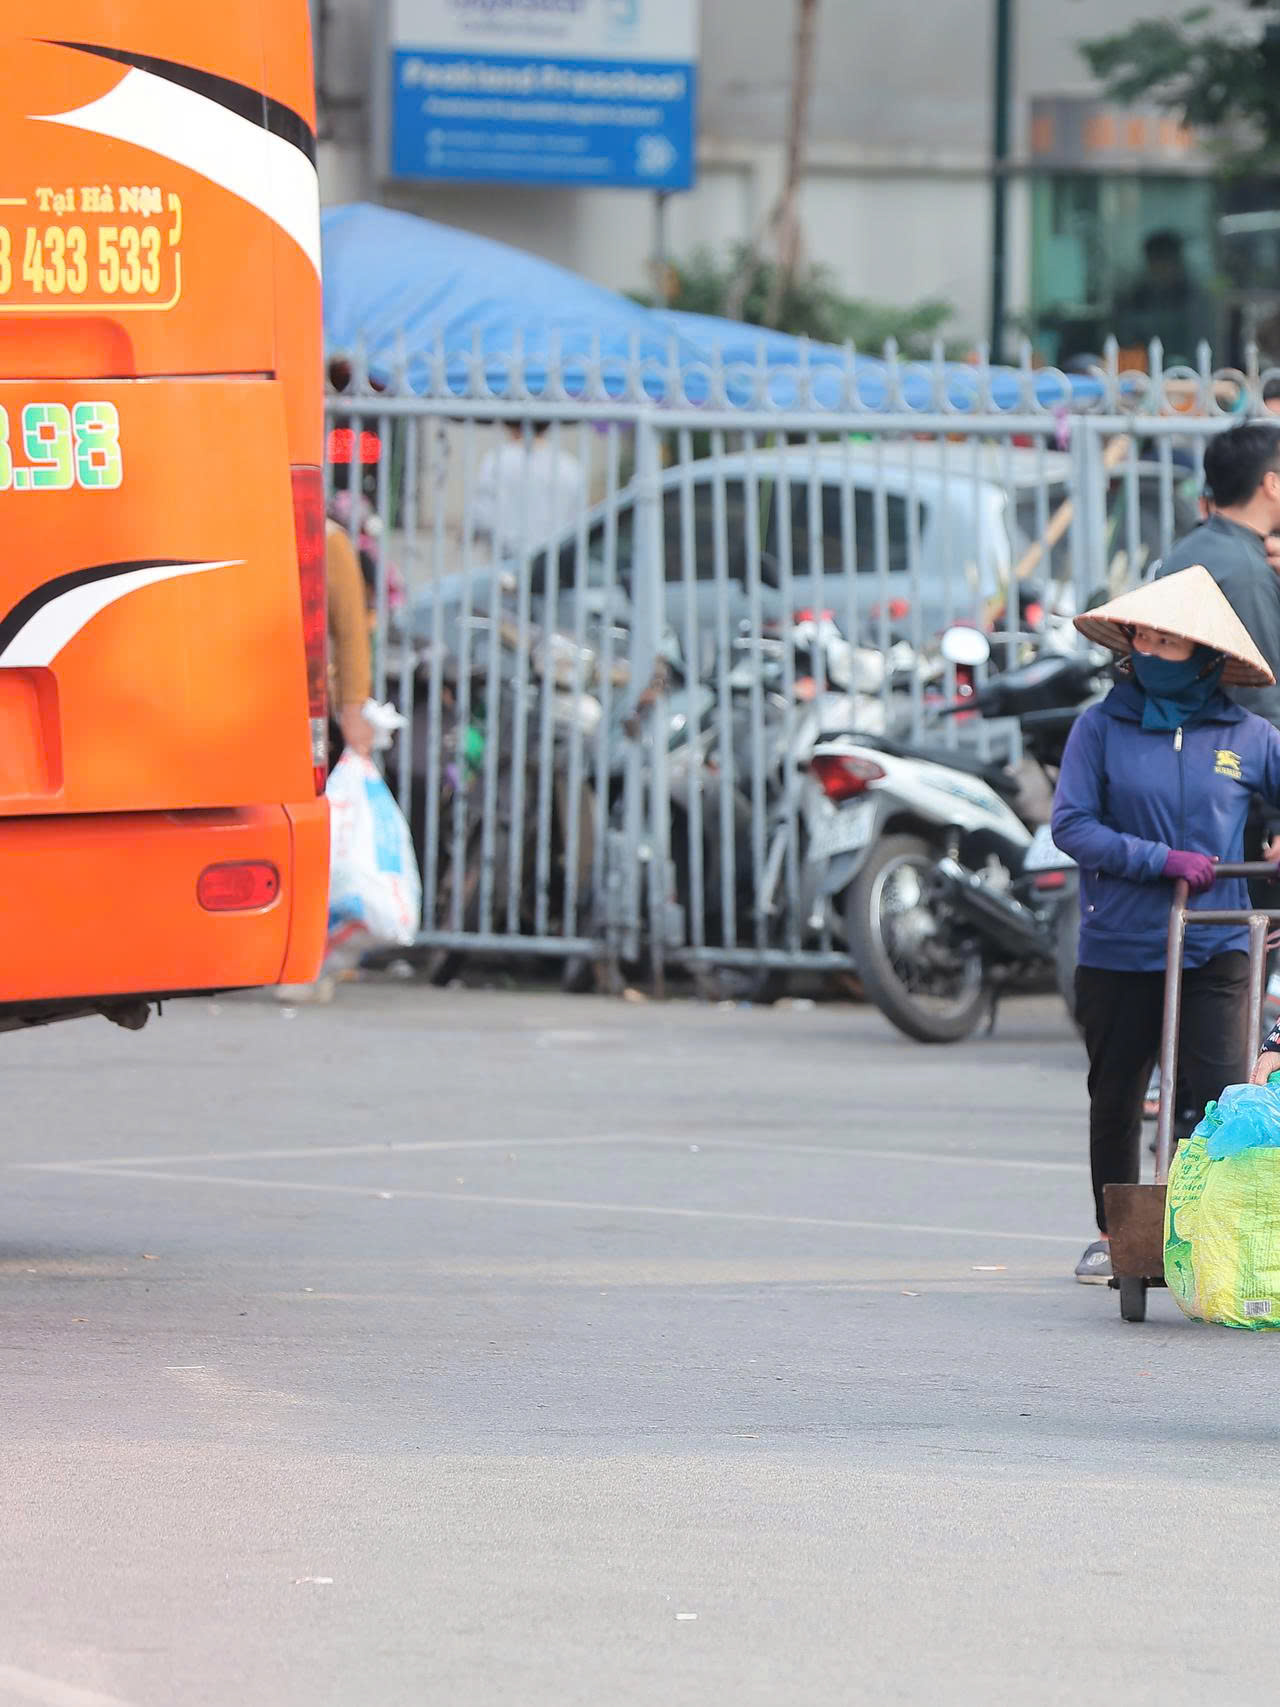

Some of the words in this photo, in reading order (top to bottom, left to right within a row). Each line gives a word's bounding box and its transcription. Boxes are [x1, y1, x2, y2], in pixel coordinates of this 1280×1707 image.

[80, 183, 115, 213] Hà
[22, 225, 89, 295] 433
[98, 225, 162, 295] 533
[0, 400, 123, 491] .98
